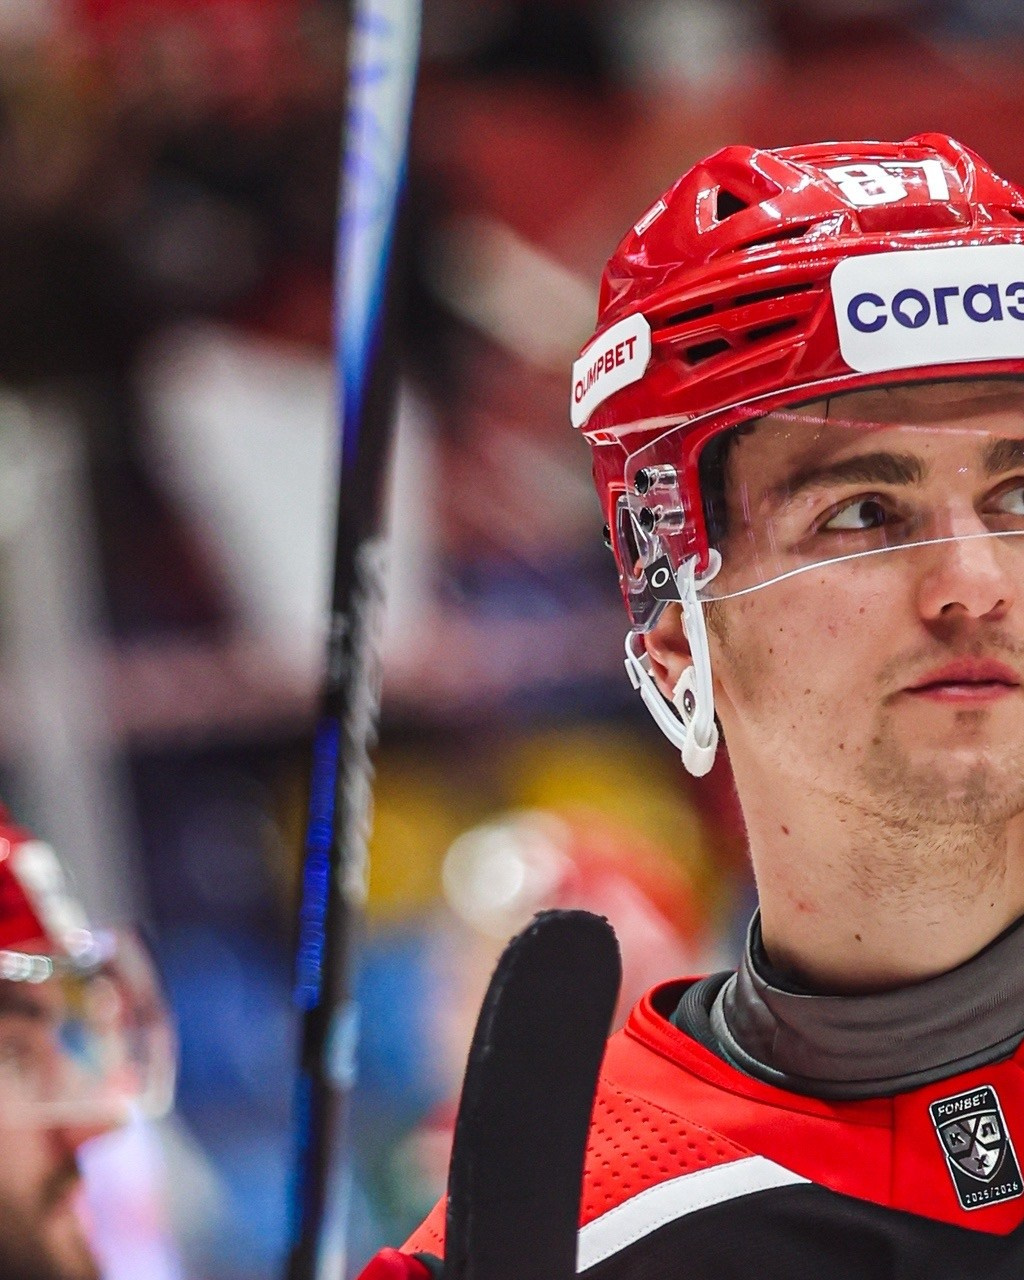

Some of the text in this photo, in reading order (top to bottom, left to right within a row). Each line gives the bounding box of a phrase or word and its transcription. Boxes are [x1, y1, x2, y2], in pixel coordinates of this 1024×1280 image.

[822, 159, 950, 206] 87
[574, 335, 637, 404] OLIMPBET
[937, 1092, 988, 1117] FONBET
[965, 1181, 1019, 1204] 2025/2026
